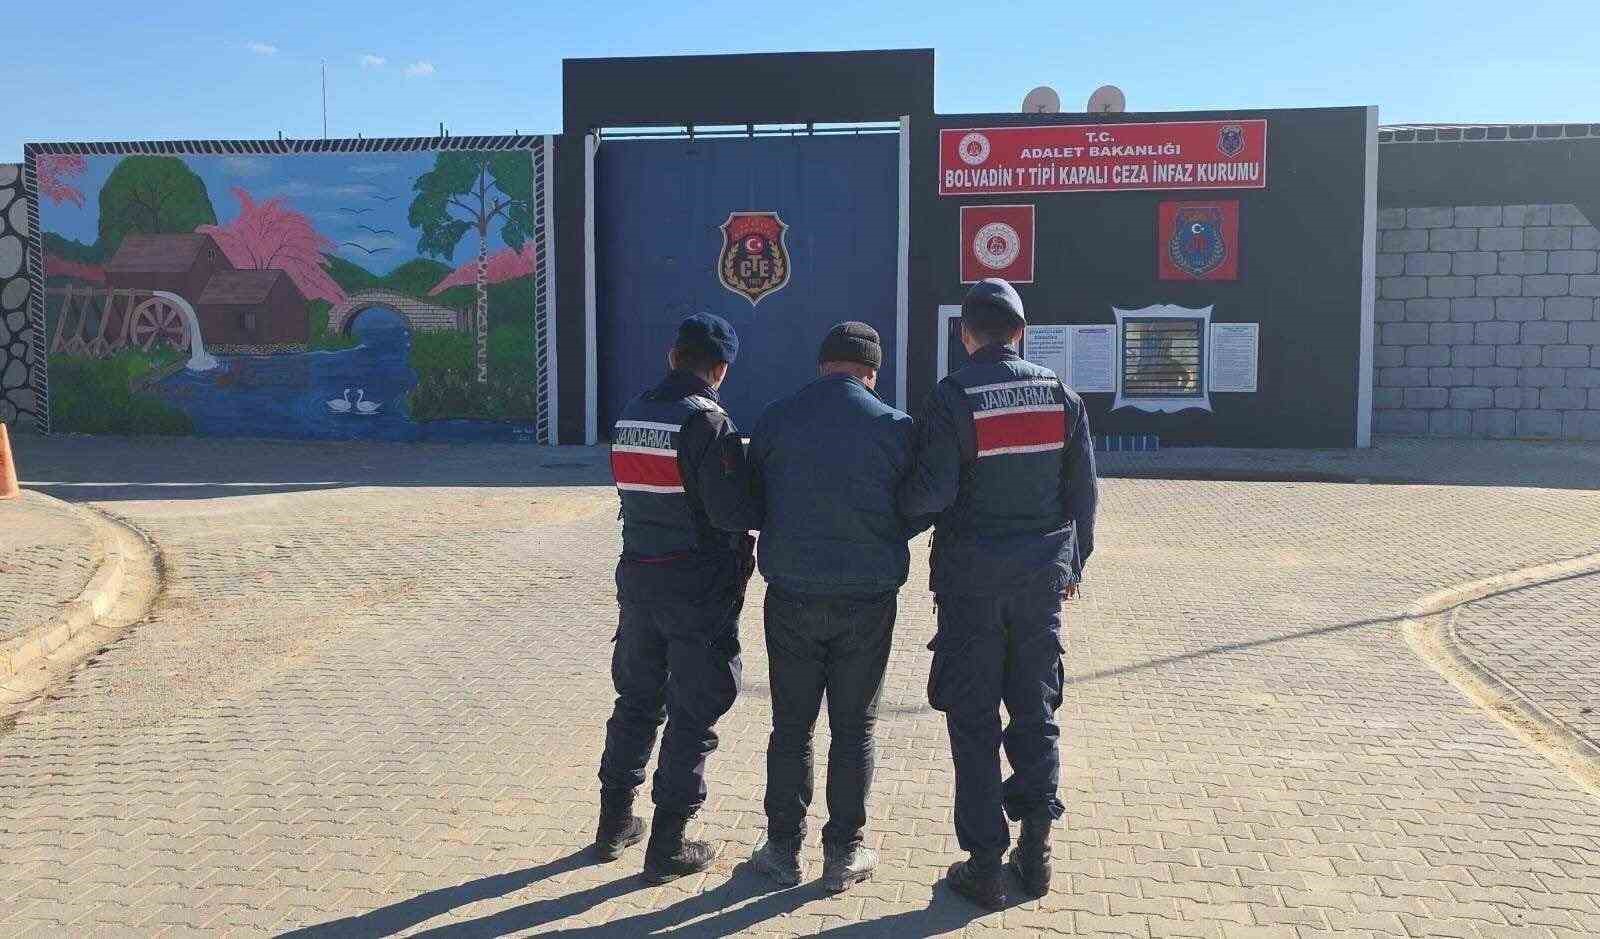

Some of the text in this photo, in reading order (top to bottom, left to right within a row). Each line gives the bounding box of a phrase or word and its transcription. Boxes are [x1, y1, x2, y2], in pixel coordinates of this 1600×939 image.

[1086, 131, 1115, 143] T.C.
[1020, 142, 1181, 159] ADALET BAKANLIĞI
[945, 160, 1259, 188] BOLVADİN T TİPİ KAPALI CEZA İNFAZ KURUMU
[981, 385, 1056, 410] JANDARMA
[616, 427, 672, 449] JANDARMA
